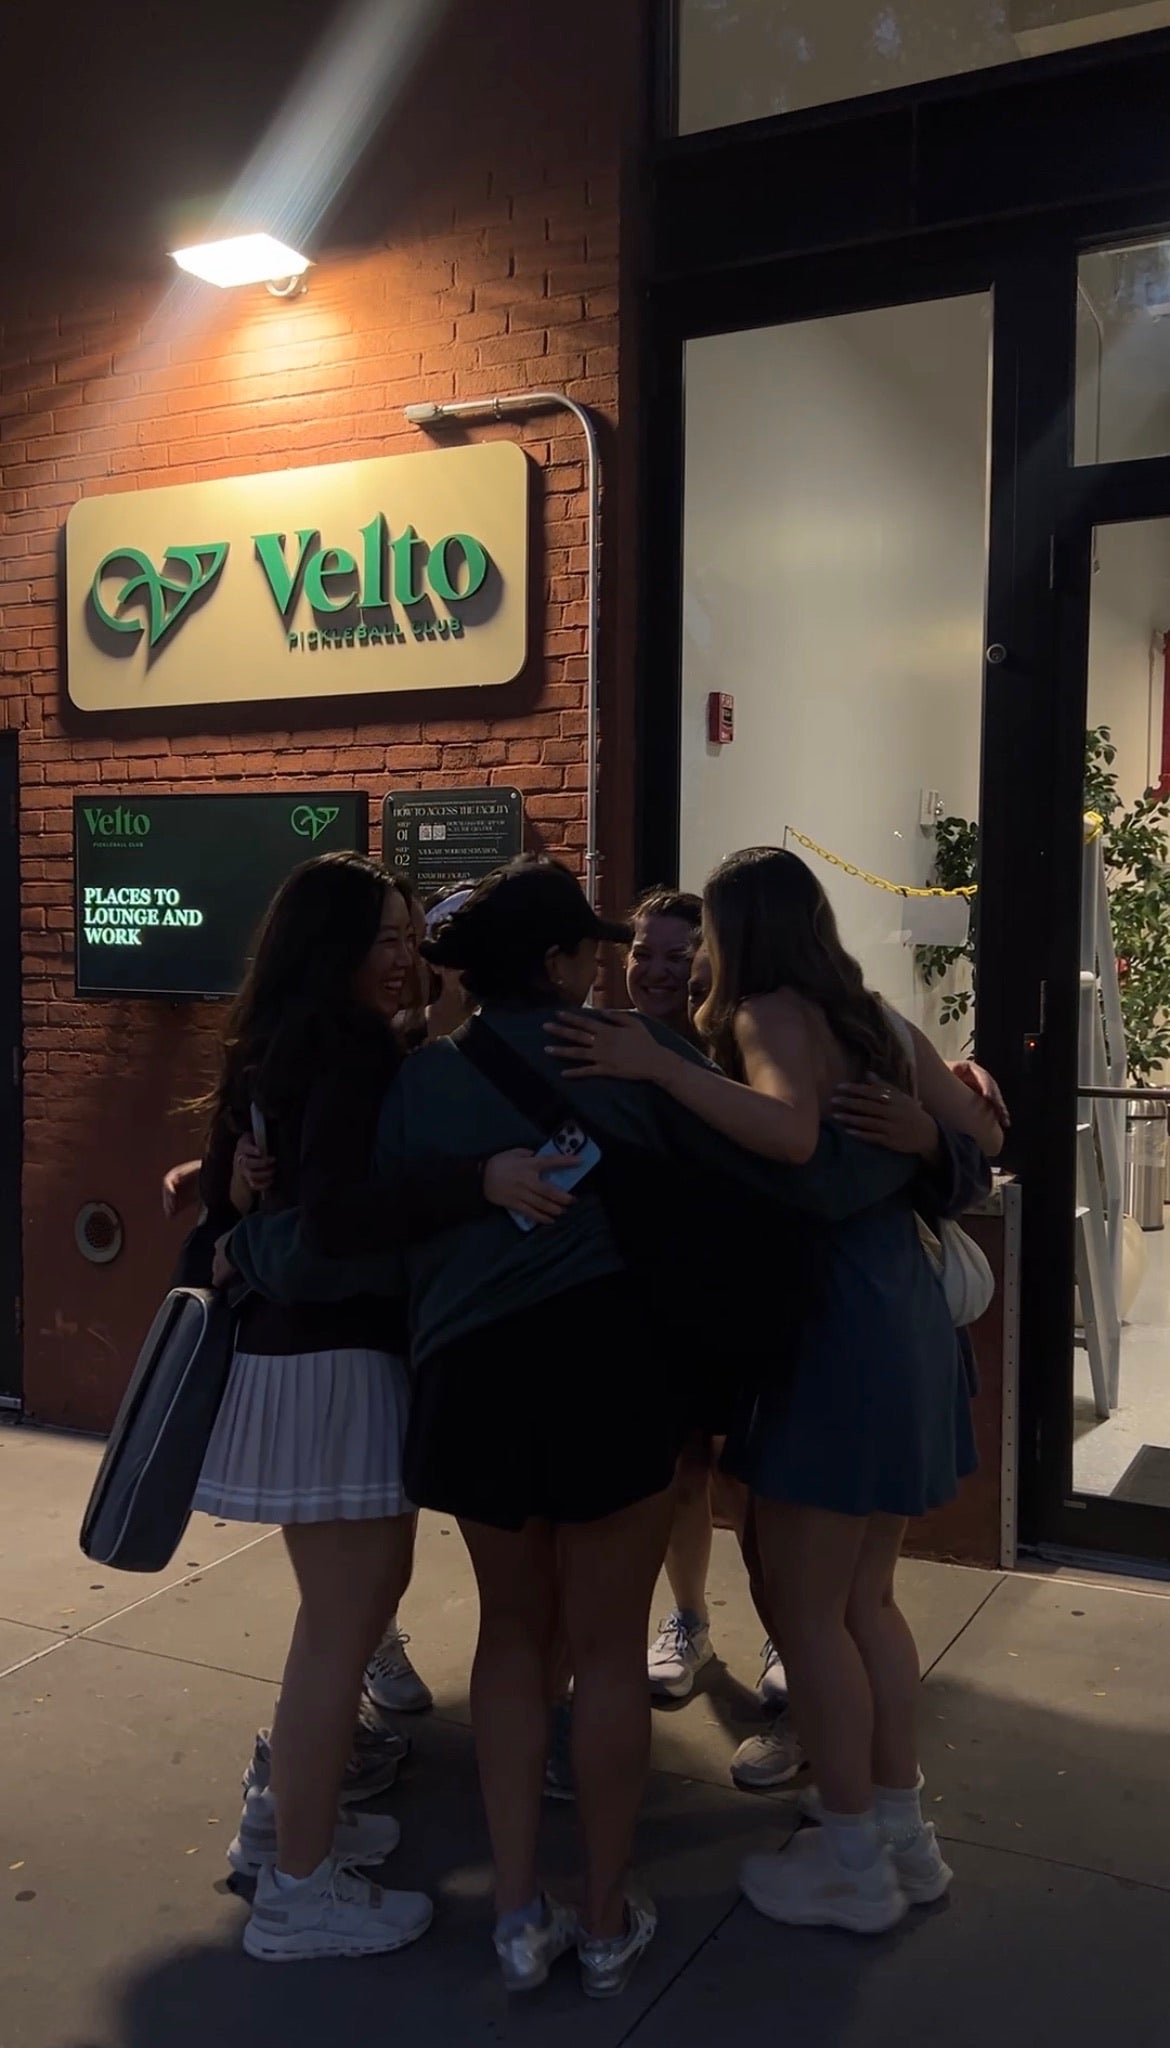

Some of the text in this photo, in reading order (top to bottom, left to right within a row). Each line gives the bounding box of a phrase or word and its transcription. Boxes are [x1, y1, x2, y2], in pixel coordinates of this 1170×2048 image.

[251, 511, 488, 615] Velto
[288, 617, 462, 644] PICKLEBALL CLUB
[84, 805, 151, 836] Velto
[415, 807, 426, 816] TO
[397, 829, 408, 841] 01
[395, 854, 410, 866] 02
[84, 888, 180, 906] PLACES TO
[84, 908, 203, 926] LOUNGE AND
[84, 928, 142, 945] WORK
